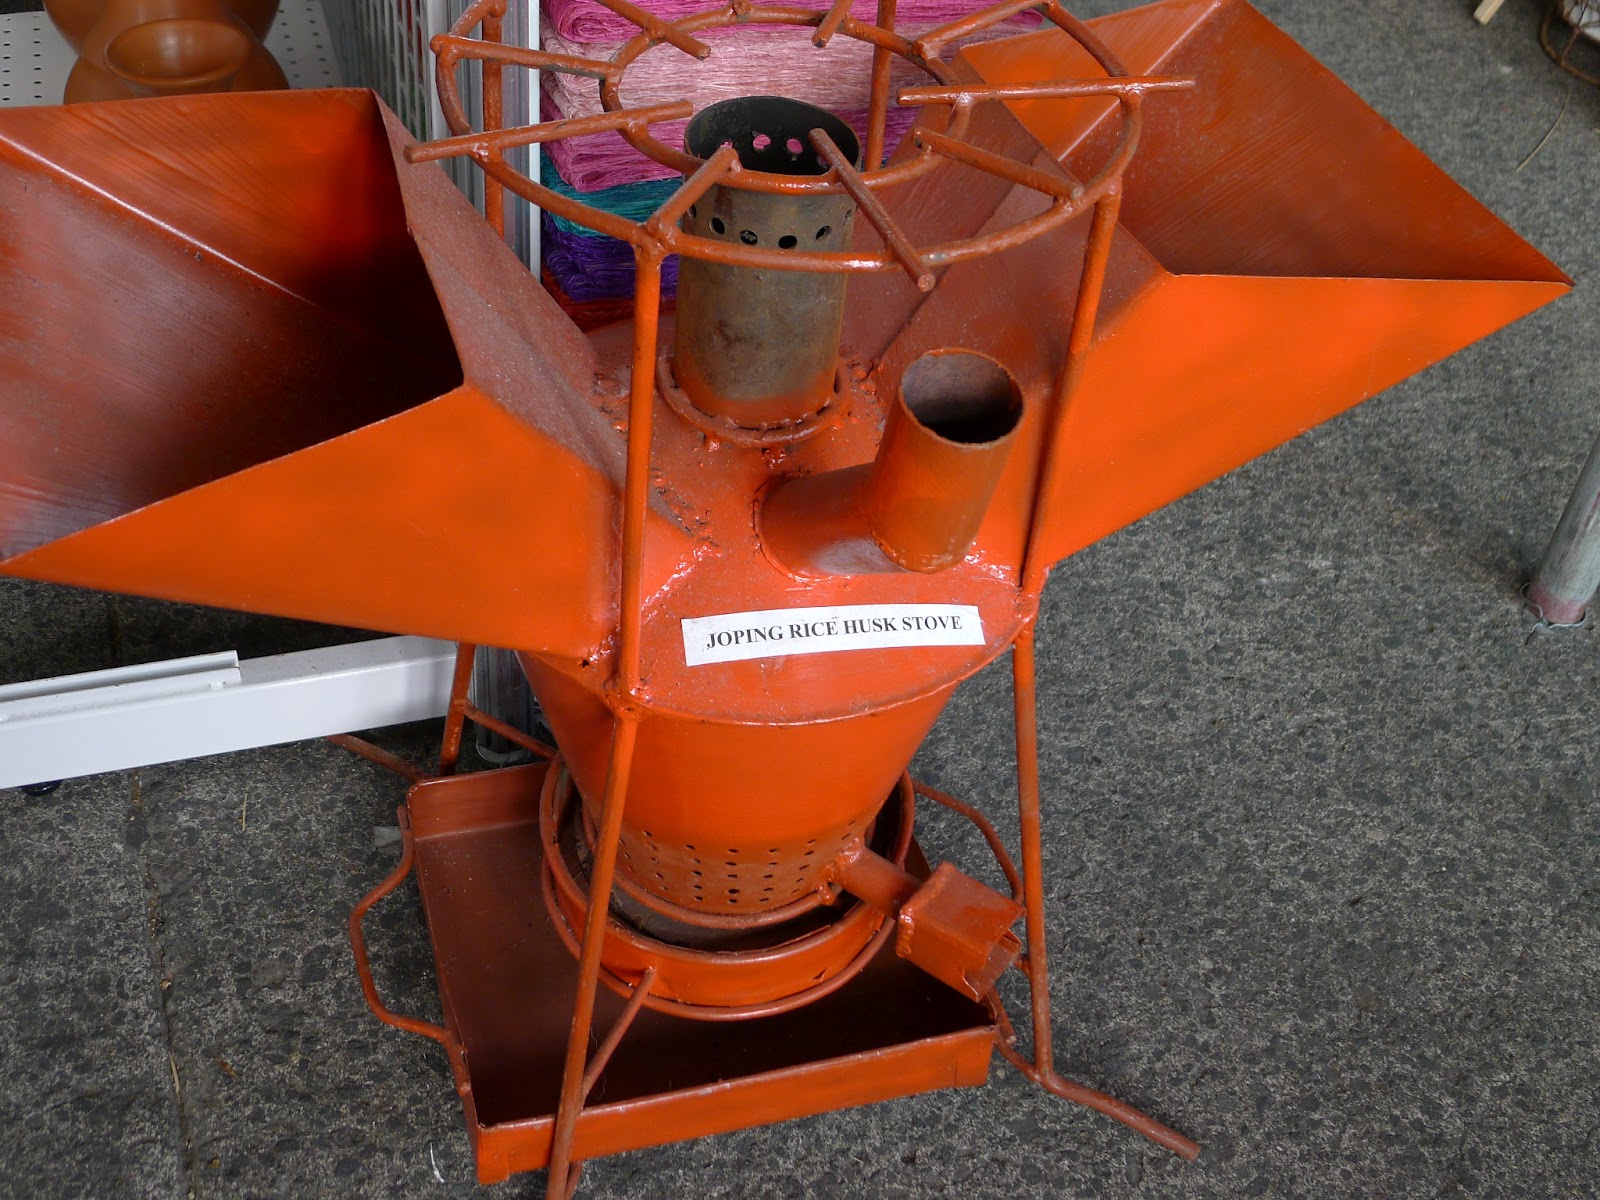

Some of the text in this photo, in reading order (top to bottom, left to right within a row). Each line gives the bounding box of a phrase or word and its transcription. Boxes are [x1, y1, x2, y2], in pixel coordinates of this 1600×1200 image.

[706, 615, 963, 649] JOPING RICE HUSK STOVE
